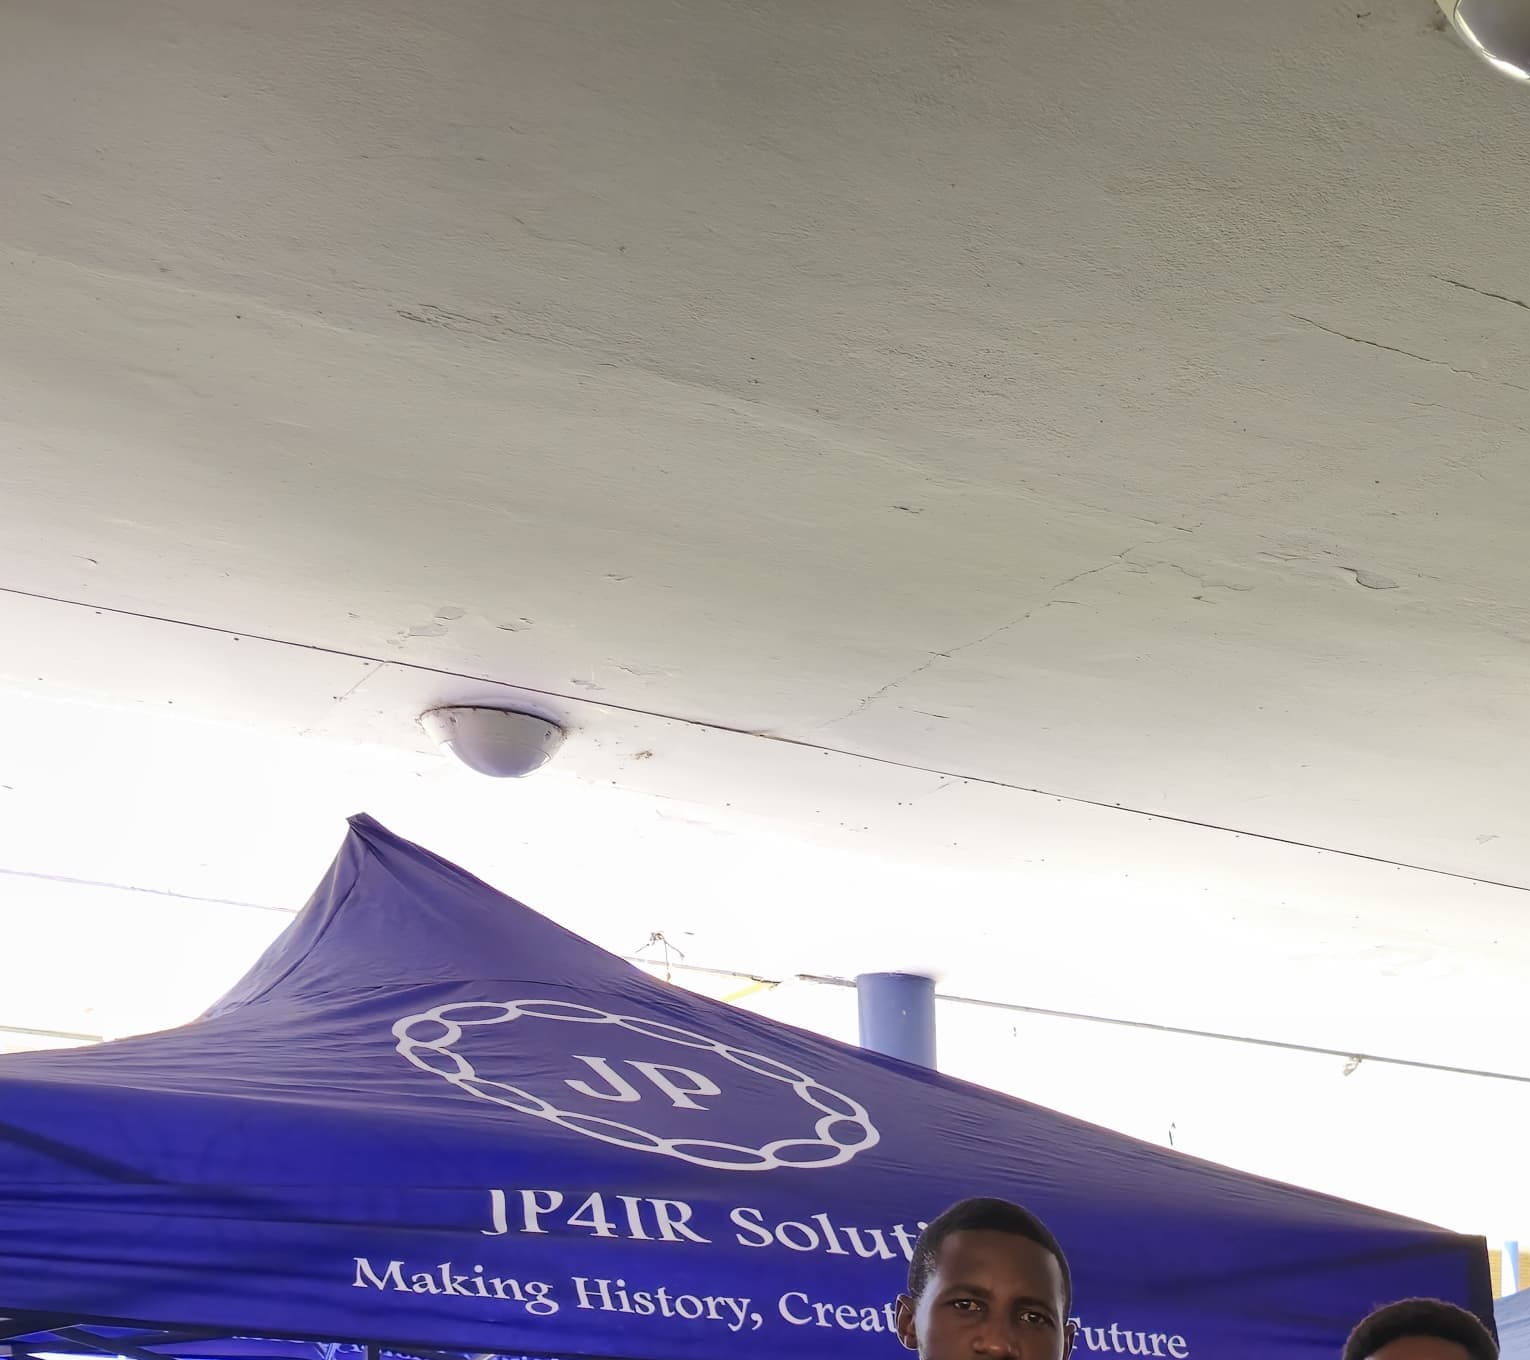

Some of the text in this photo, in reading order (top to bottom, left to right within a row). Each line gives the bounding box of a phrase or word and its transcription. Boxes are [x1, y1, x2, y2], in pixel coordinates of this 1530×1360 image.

[563, 1054, 722, 1111] JP
[480, 1189, 712, 1243] JP4IR
[352, 1257, 559, 1316] Making
[570, 1276, 763, 1332] History,
